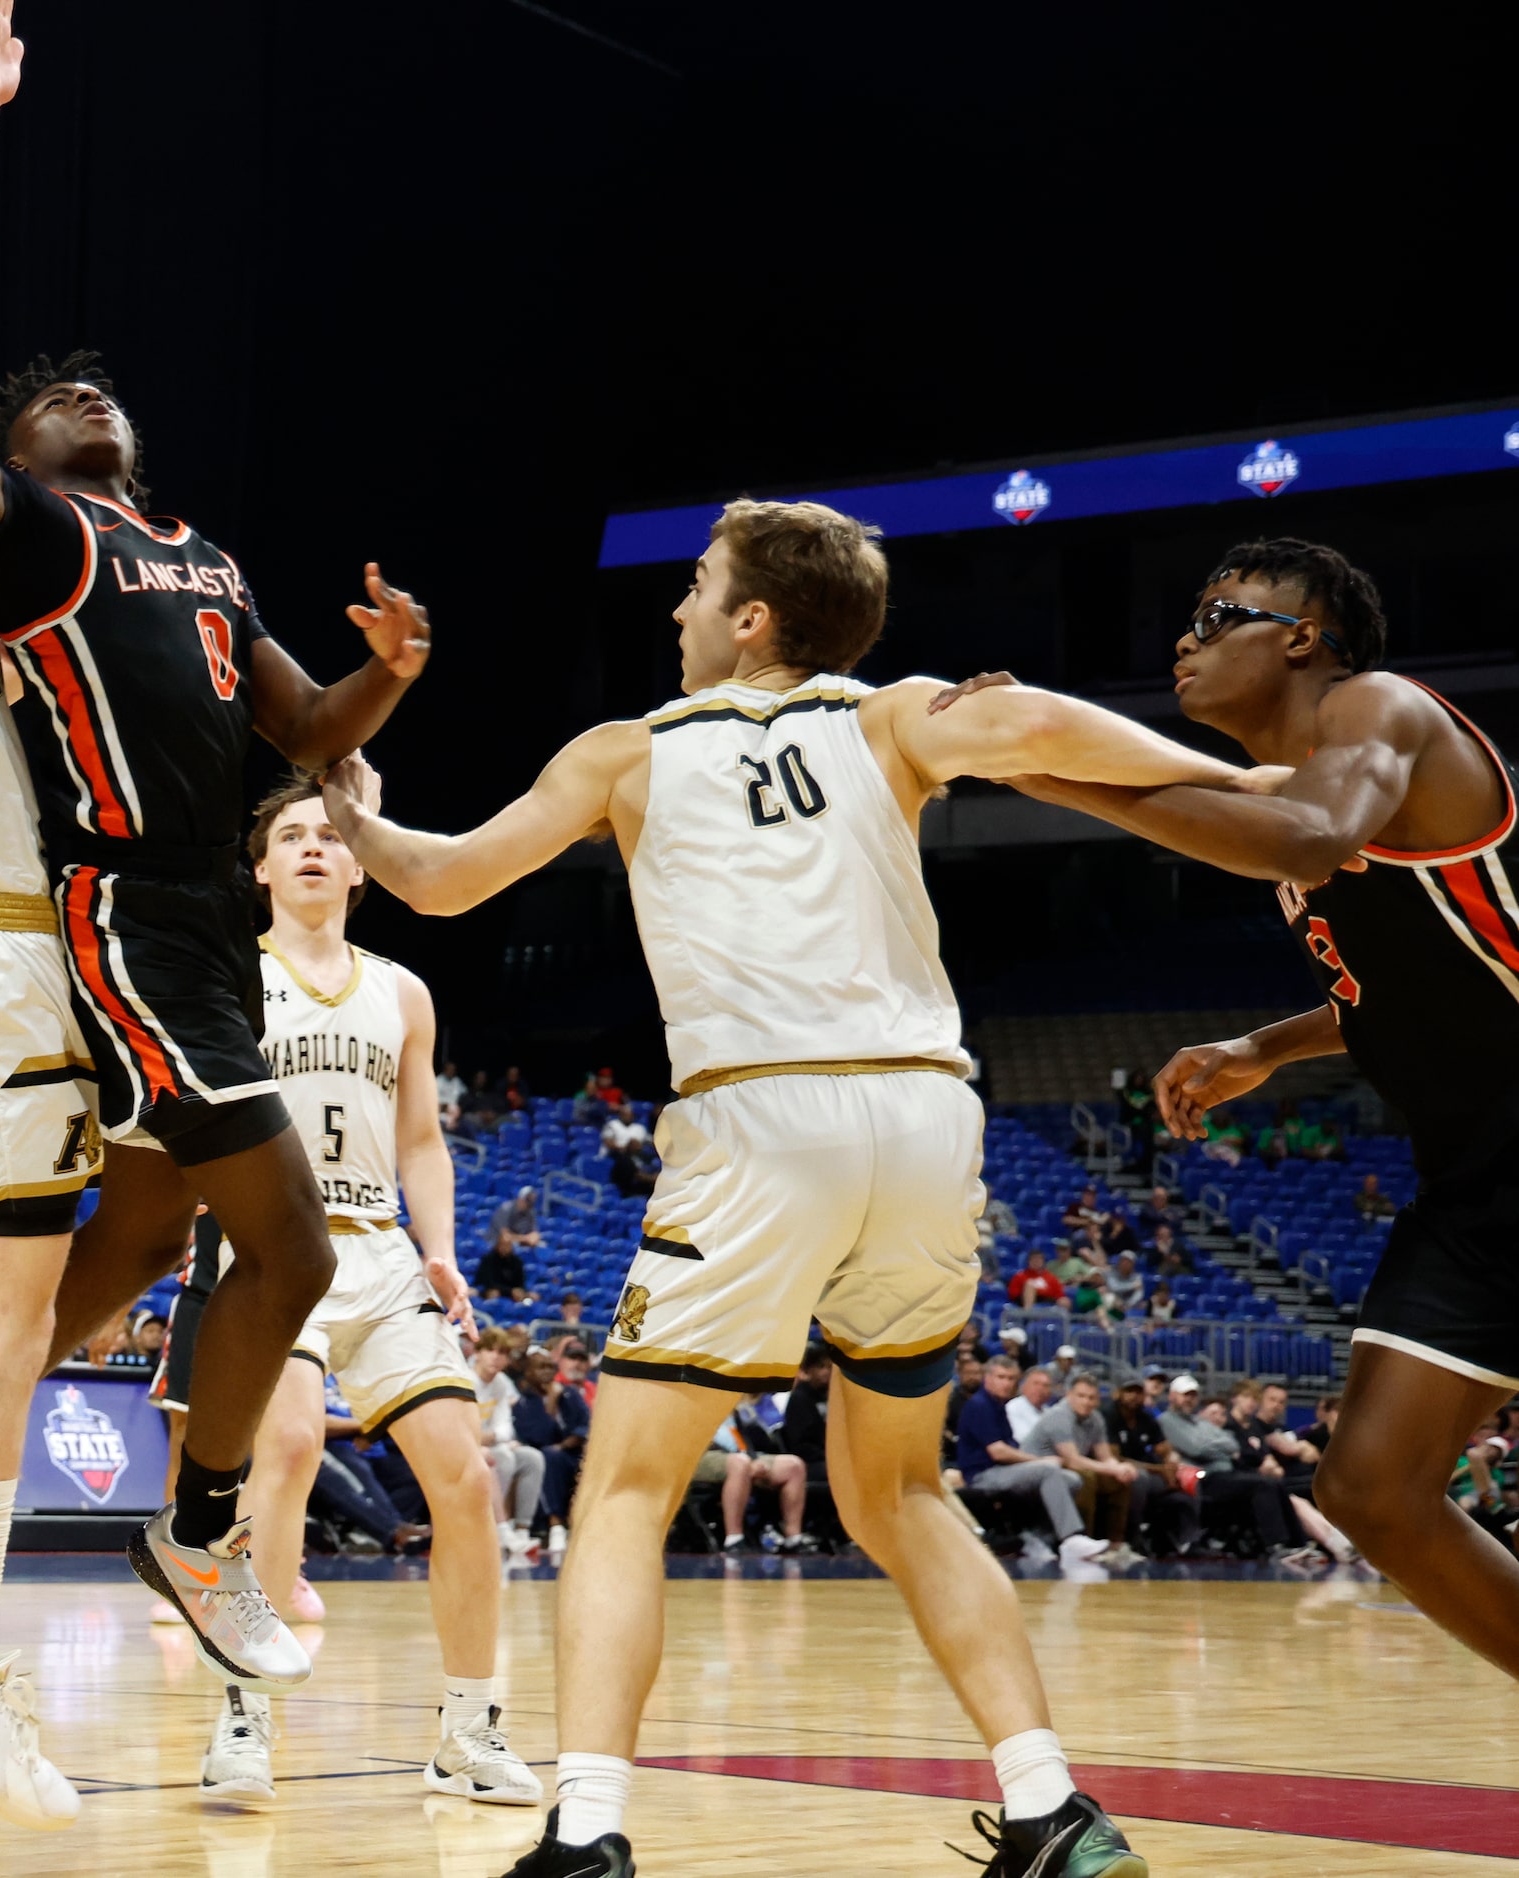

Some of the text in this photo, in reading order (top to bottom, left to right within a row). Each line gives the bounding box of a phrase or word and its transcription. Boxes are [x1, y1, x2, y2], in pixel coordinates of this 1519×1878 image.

[1240, 459, 1299, 481] STATE
[994, 487, 1050, 510] STATE
[111, 556, 250, 612] LANCASTE
[195, 607, 240, 702] 0
[736, 741, 832, 831] 20
[264, 1033, 359, 1080] MARILLO
[321, 1102, 346, 1165] 5
[48, 1432, 123, 1461] STATE
